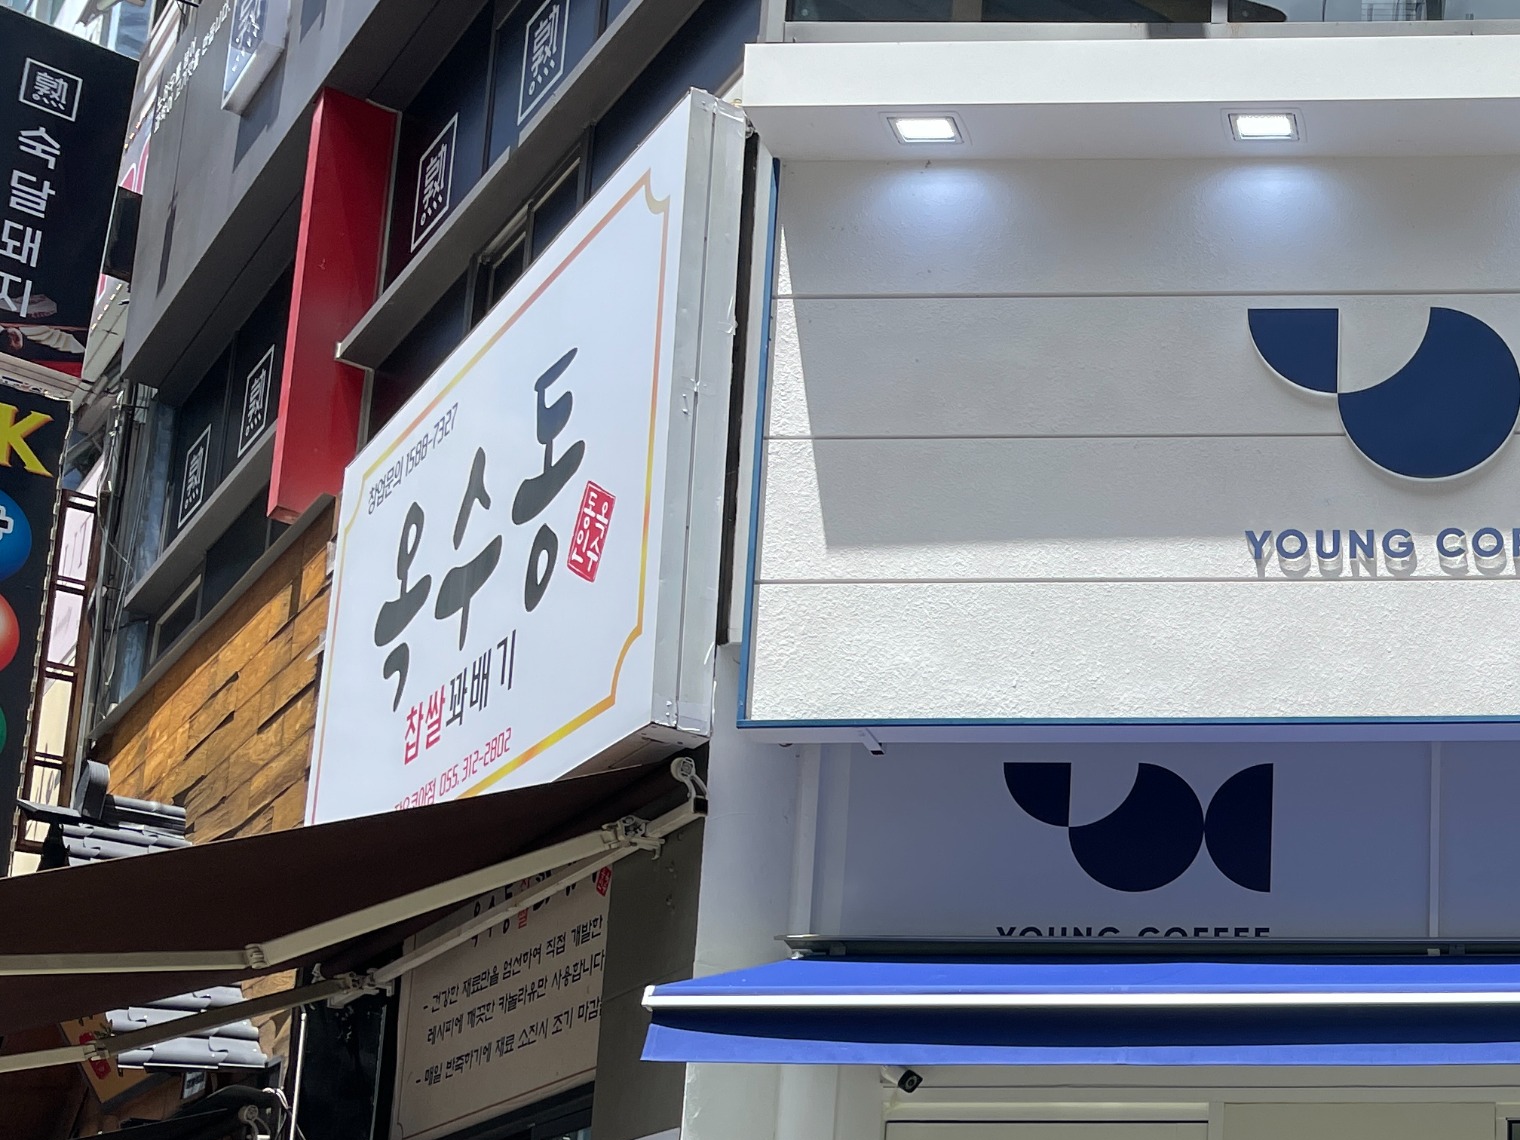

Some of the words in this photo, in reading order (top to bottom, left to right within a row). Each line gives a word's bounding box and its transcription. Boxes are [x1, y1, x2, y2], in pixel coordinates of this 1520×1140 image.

[0, 126, 60, 318] 숙달돼지
[367, 460, 402, 516] 창업문의
[405, 402, 458, 478] 1588-7327
[374, 347, 586, 713] 옥수동
[1245, 528, 1415, 560] YOUNG
[427, 1015, 464, 1045] 레시피에
[498, 976, 548, 1014] 카놀라유만
[551, 949, 605, 990] 사용합니다
[432, 985, 459, 1013] 건강한
[462, 966, 499, 996] 재료만을
[502, 943, 542, 980] 엄선하여
[546, 933, 566, 957] 직접
[571, 915, 604, 946] 개발한
[445, 1042, 491, 1078] 반죽하기에
[495, 1033, 515, 1057] 재료
[517, 1018, 549, 1049] 소진시
[551, 1008, 573, 1035] 조기
